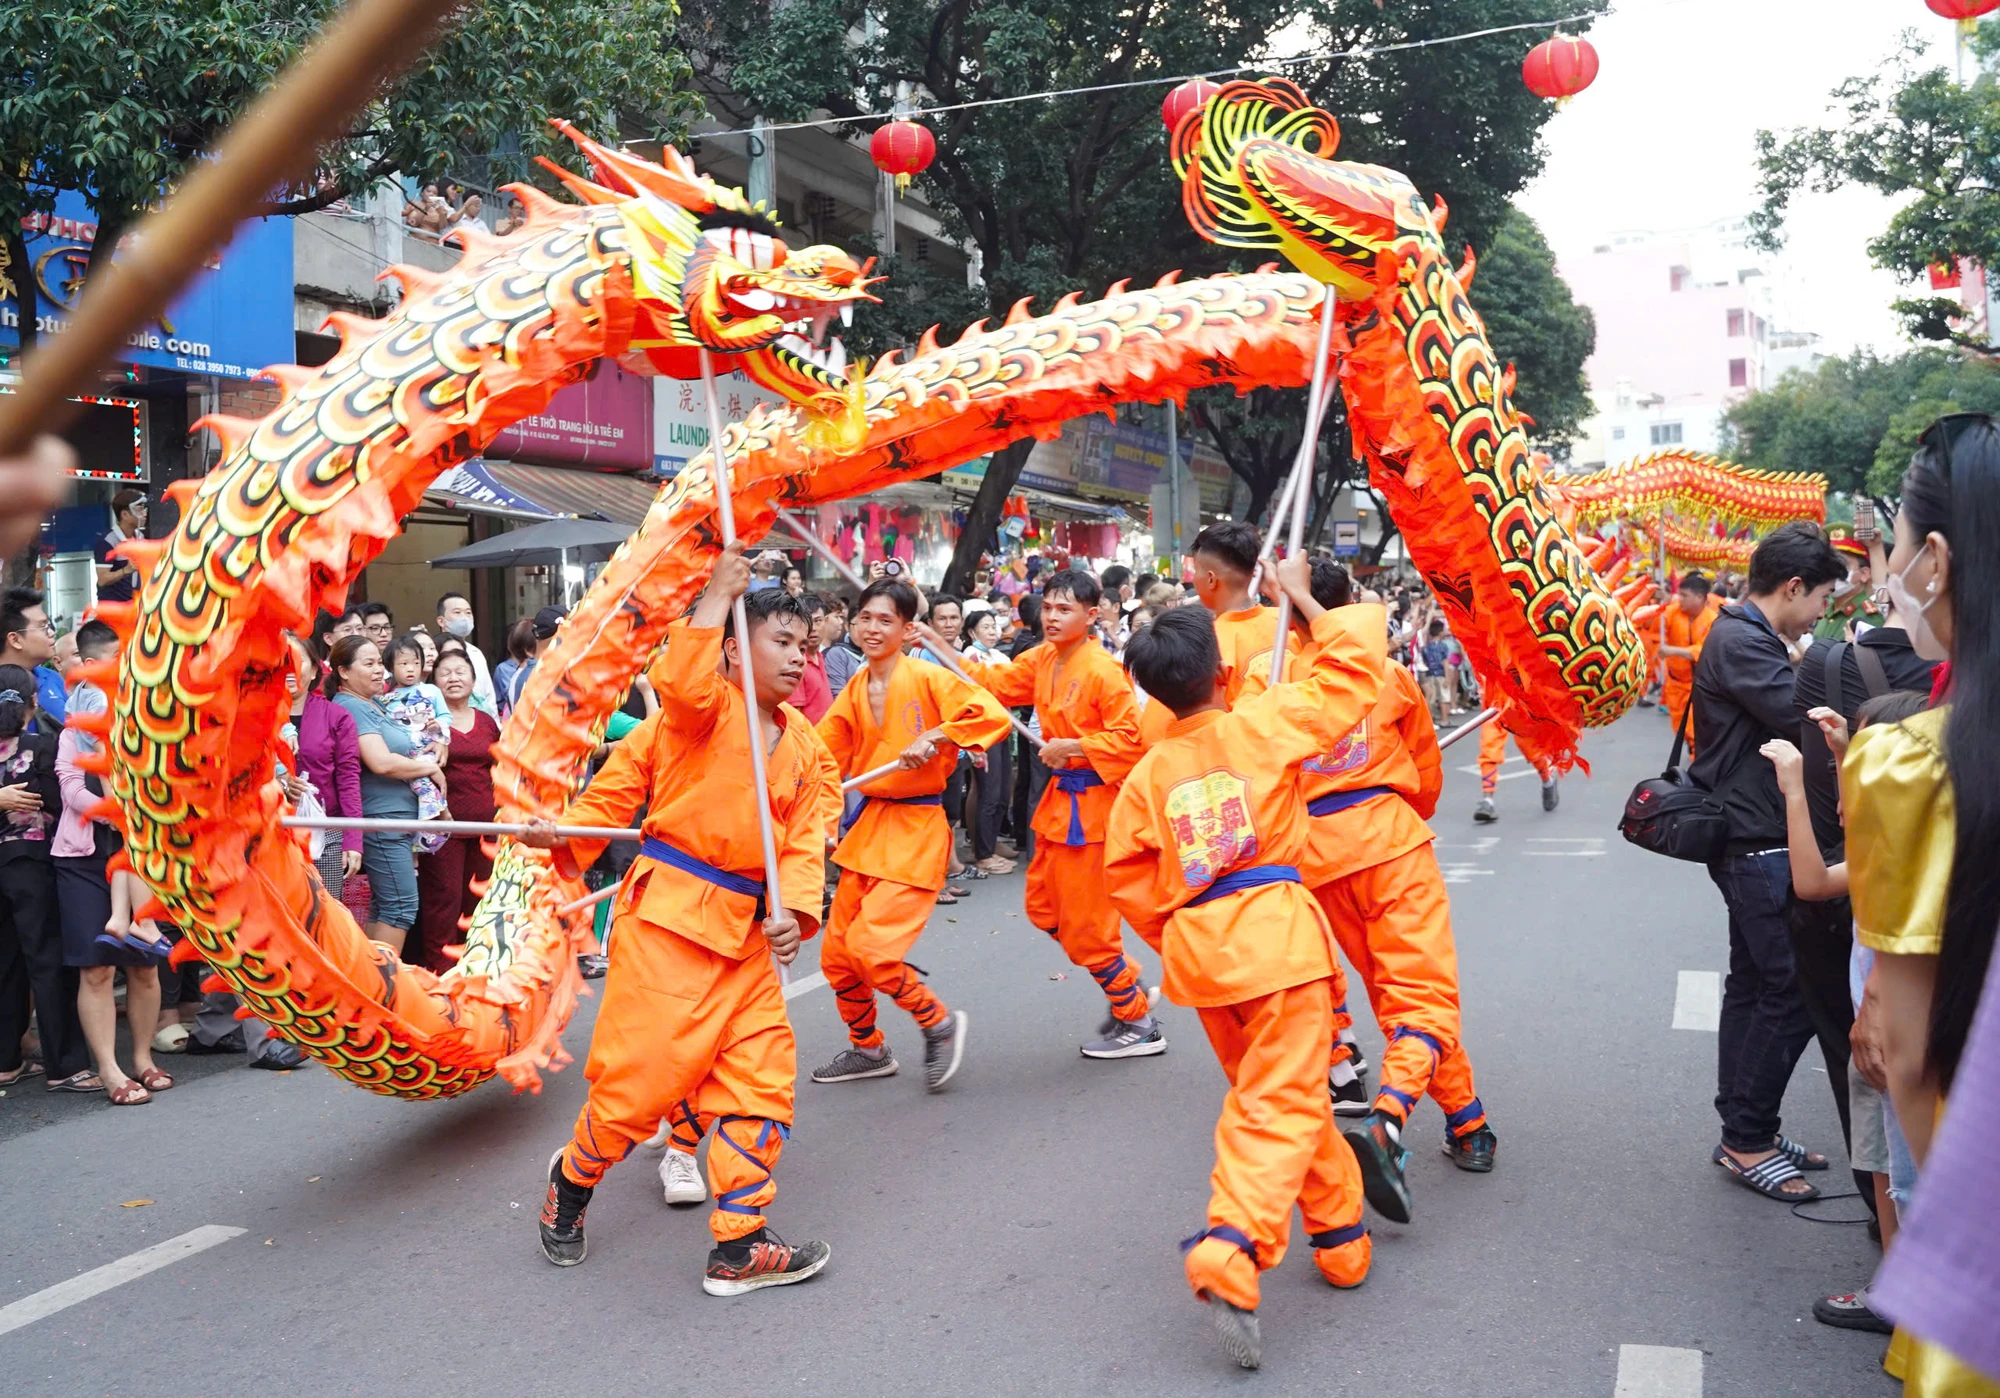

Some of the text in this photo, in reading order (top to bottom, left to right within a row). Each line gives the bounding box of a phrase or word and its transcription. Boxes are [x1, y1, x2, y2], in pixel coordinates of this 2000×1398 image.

[176, 357, 192, 369] TEL:
[193, 360, 206, 371] 028
[207, 362, 224, 374] 3950
[225, 364, 241, 376] 7973
[540, 415, 557, 429] THỜI
[559, 419, 582, 433] TRANG
[613, 427, 624, 439] EM
